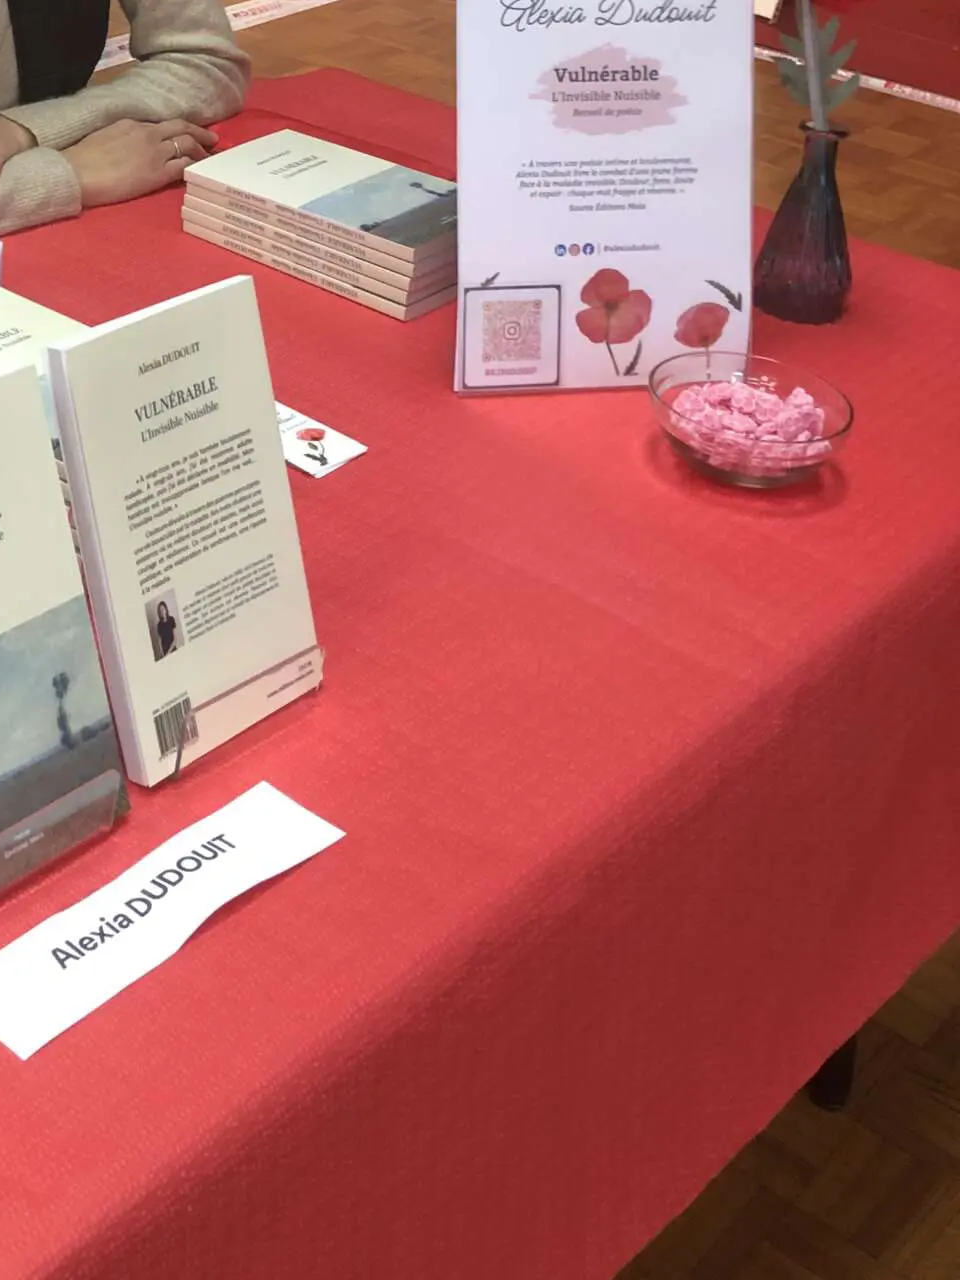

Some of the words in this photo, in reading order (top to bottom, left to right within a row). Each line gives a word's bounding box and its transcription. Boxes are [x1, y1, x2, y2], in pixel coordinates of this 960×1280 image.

[554, 65, 660, 83] Vulnérable
[551, 89, 612, 103] L'Invisible
[613, 89, 661, 102] Nuisible
[138, 355, 163, 377] Alexia
[161, 340, 202, 367] DUDOUIT
[133, 375, 219, 424] VULNÉRABLE
[140, 416, 184, 444] L'Invisible
[183, 399, 220, 426] Nuisible
[50, 907, 134, 970] Alexia
[125, 832, 238, 923] DUDOUIT
